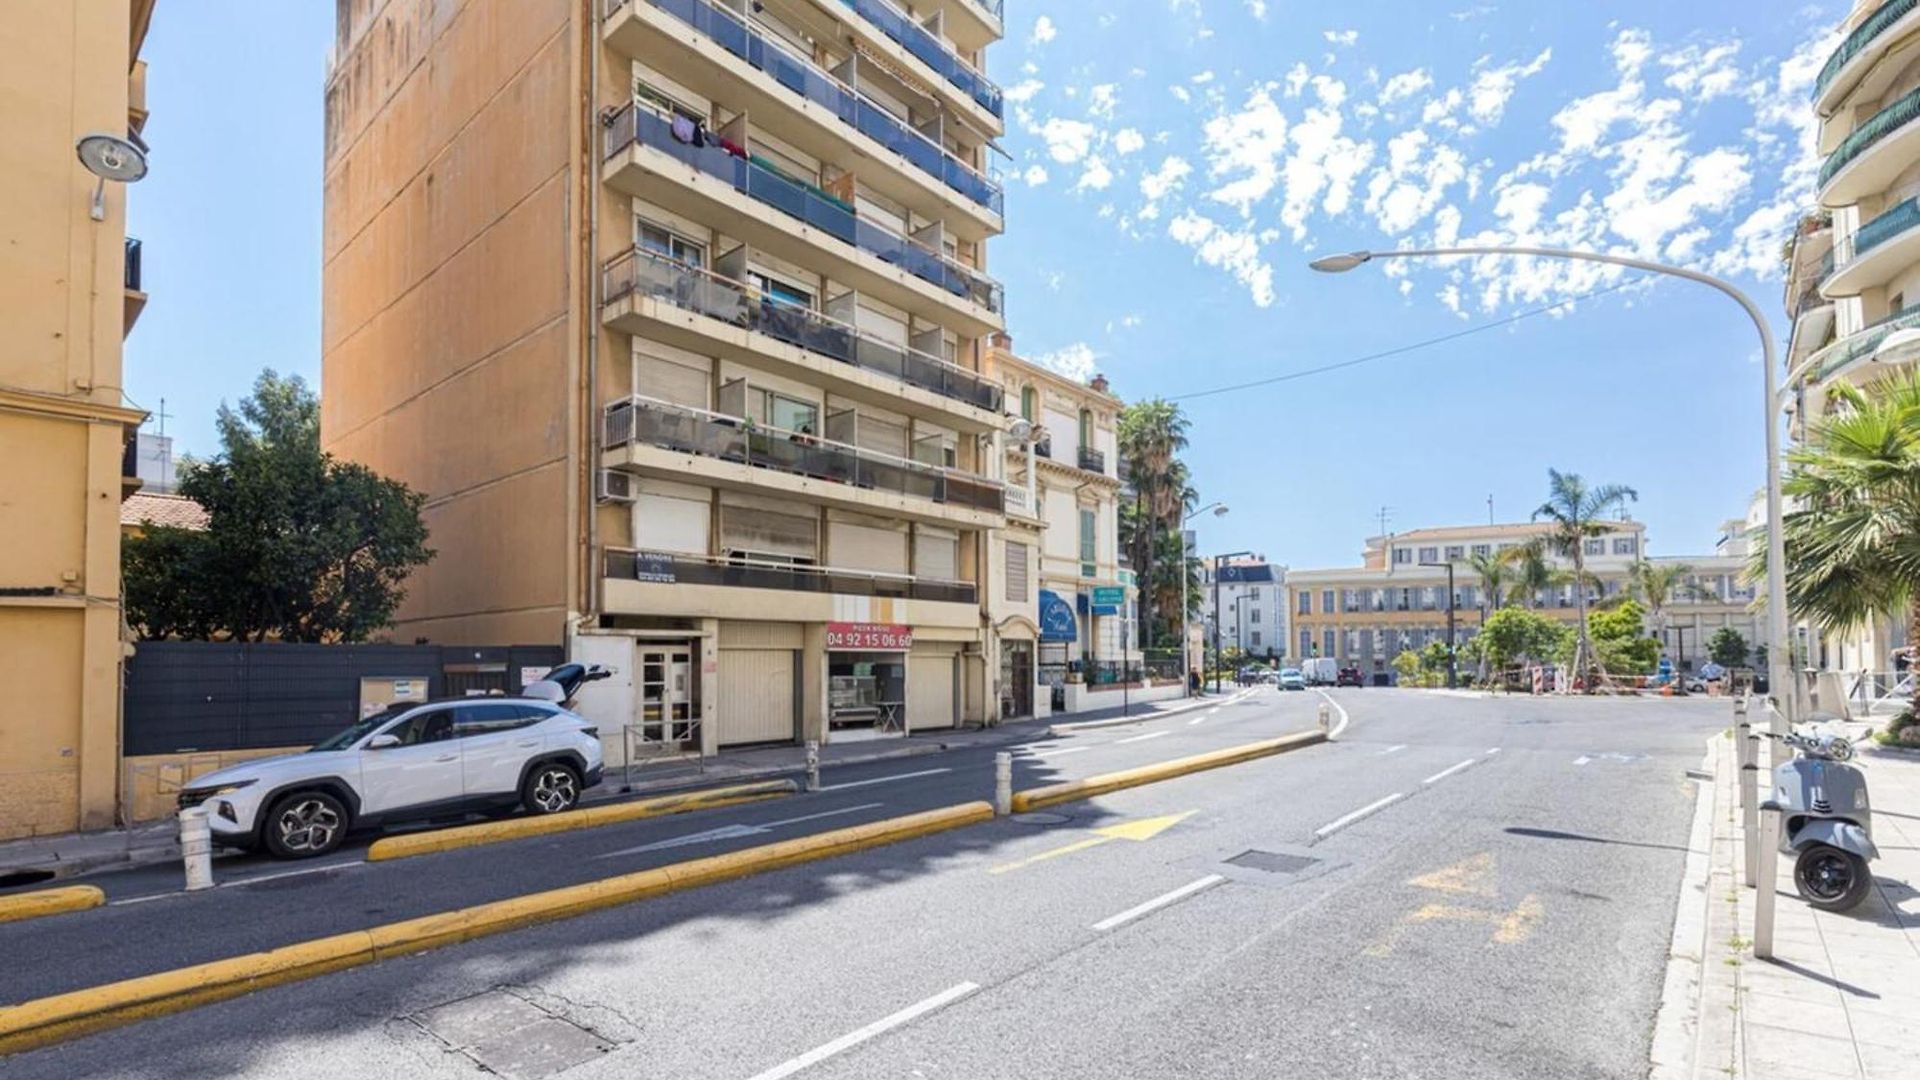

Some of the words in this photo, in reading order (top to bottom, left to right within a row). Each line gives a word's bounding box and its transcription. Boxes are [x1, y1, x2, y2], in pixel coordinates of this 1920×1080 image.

[828, 632, 842, 645] 04
[847, 633, 861, 646] 92
[865, 633, 879, 647] 15
[882, 634, 896, 647] 06
[899, 634, 912, 647] 60
